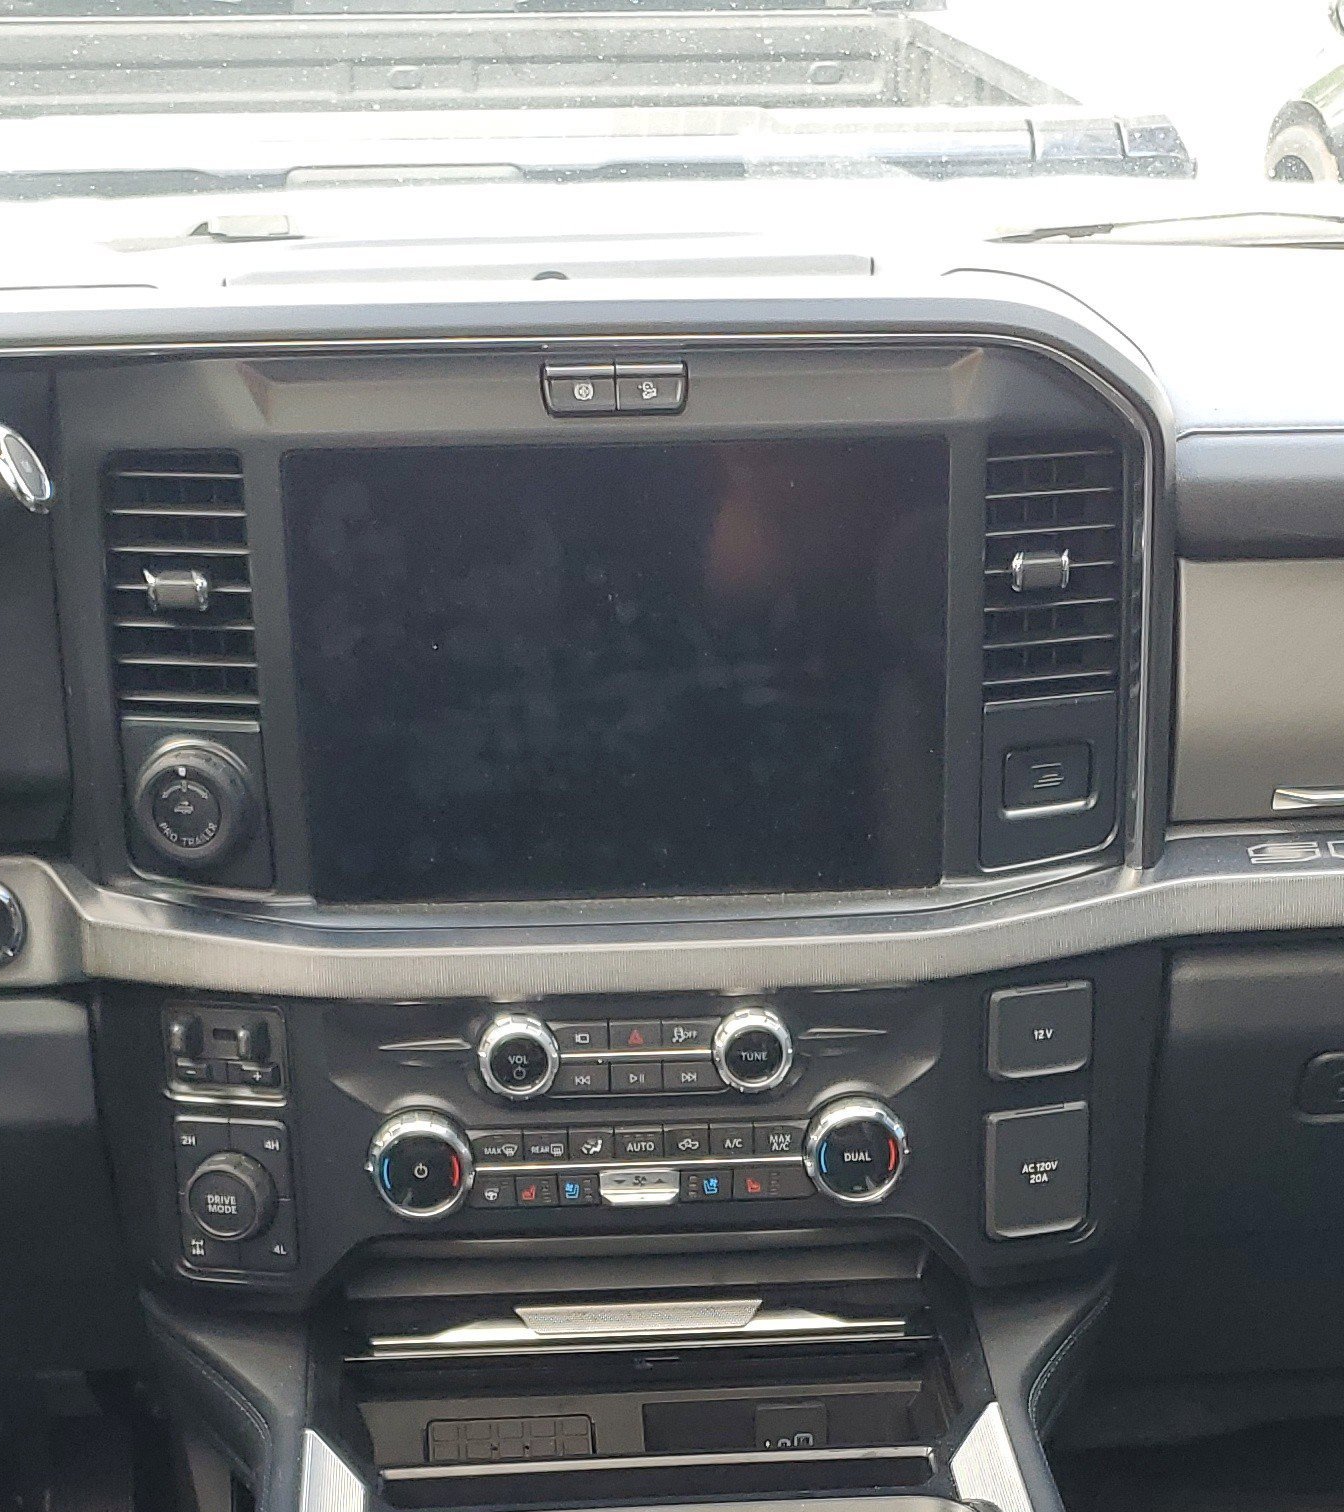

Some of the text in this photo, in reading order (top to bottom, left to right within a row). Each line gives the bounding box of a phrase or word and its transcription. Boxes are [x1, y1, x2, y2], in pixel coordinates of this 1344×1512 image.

[684, 1030, 698, 1039] OFF
[508, 1055, 528, 1064] VOL
[741, 1051, 768, 1061] TUNE
[180, 1135, 196, 1146] 2H
[724, 1138, 743, 1149] A/C
[769, 1134, 792, 1144] MAX
[263, 1139, 279, 1150] 4H
[531, 1145, 550, 1154] REAR
[626, 1142, 655, 1152] AUTO
[771, 1142, 790, 1151] A/C
[484, 1147, 501, 1155] MAX
[843, 1150, 872, 1162] DUAL
[1022, 1160, 1058, 1174] AC 120V
[1030, 1173, 1049, 1184] 20A
[207, 1194, 237, 1205] DRIVE
[208, 1205, 238, 1215] MODE
[272, 1243, 287, 1255] 4L
